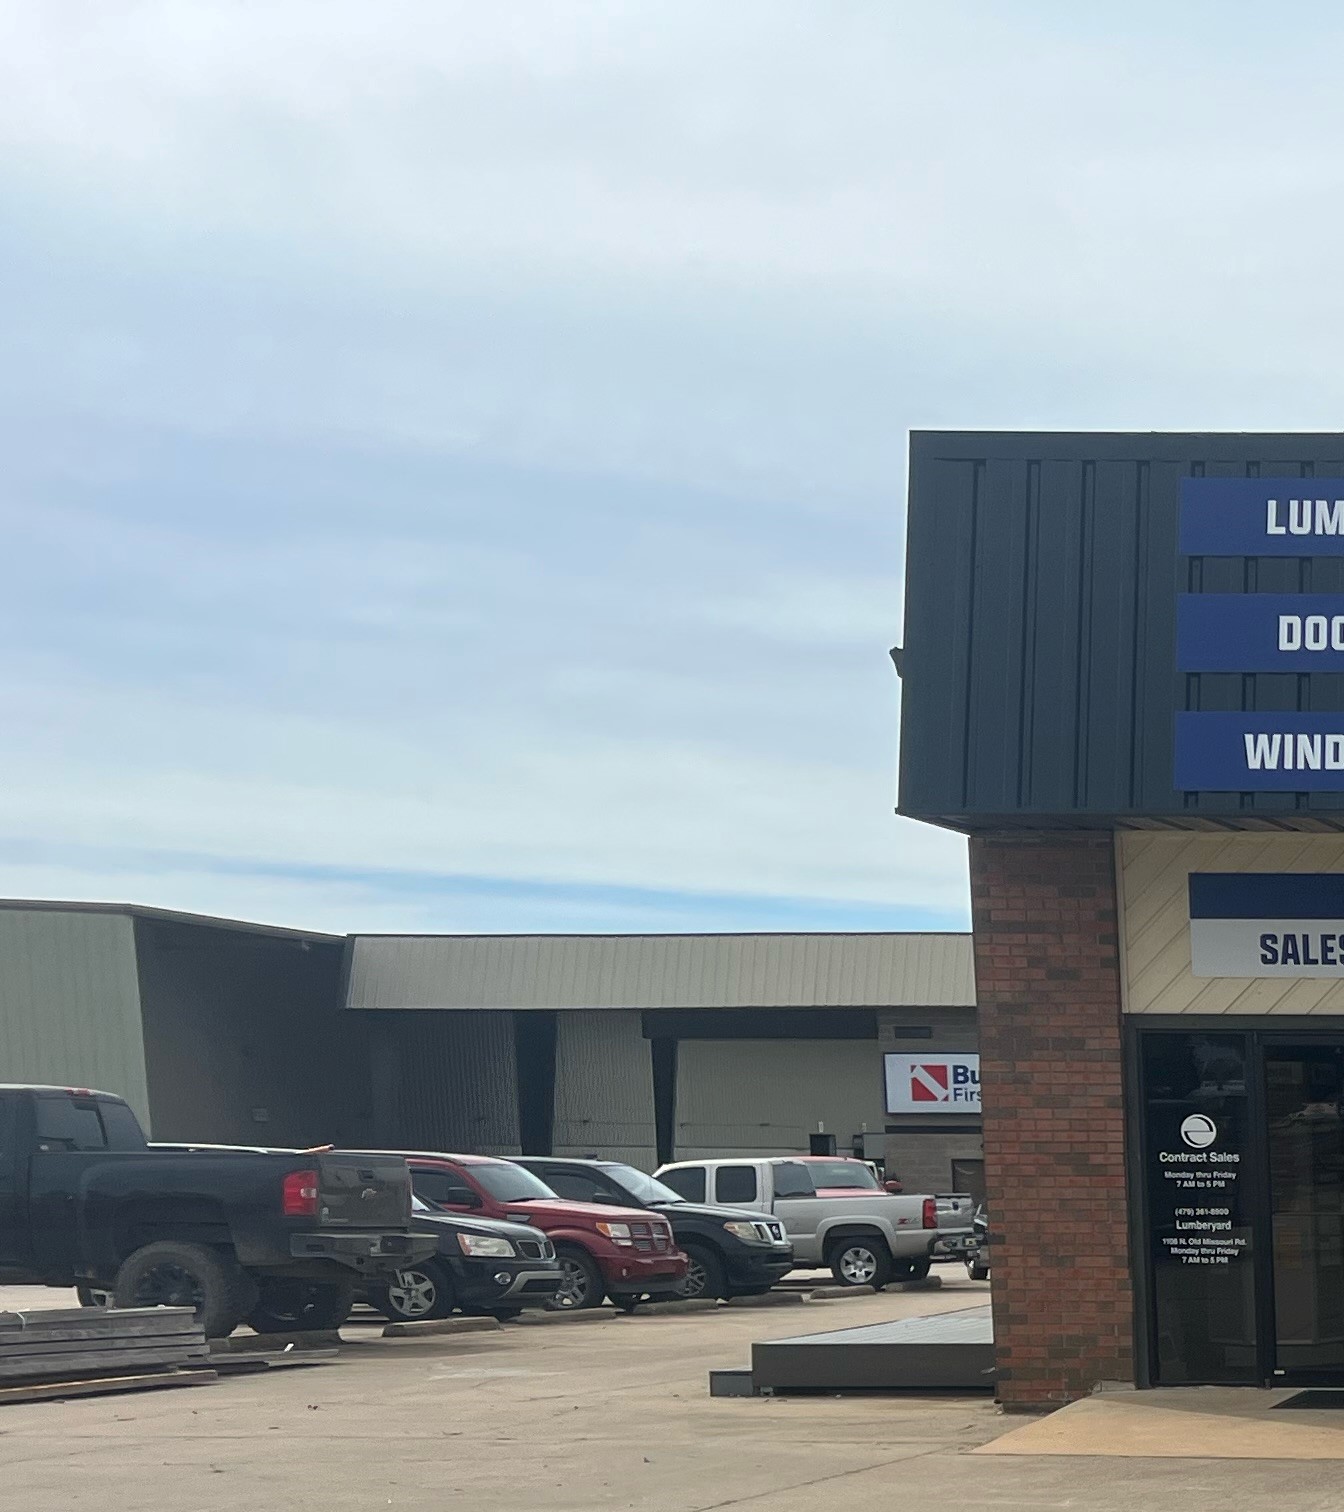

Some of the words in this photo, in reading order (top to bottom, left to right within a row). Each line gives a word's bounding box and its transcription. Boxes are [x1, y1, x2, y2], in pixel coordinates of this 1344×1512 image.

[1159, 1152, 1207, 1163] Contract
[1209, 1152, 1240, 1163] Sales
[1164, 1171, 1195, 1180] Monday
[1195, 1171, 1212, 1179] thru
[1213, 1171, 1237, 1180] Friday
[1176, 1220, 1232, 1232] Lumberyard
[1170, 1247, 1200, 1256] Monday
[1216, 1247, 1240, 1257] Friday
